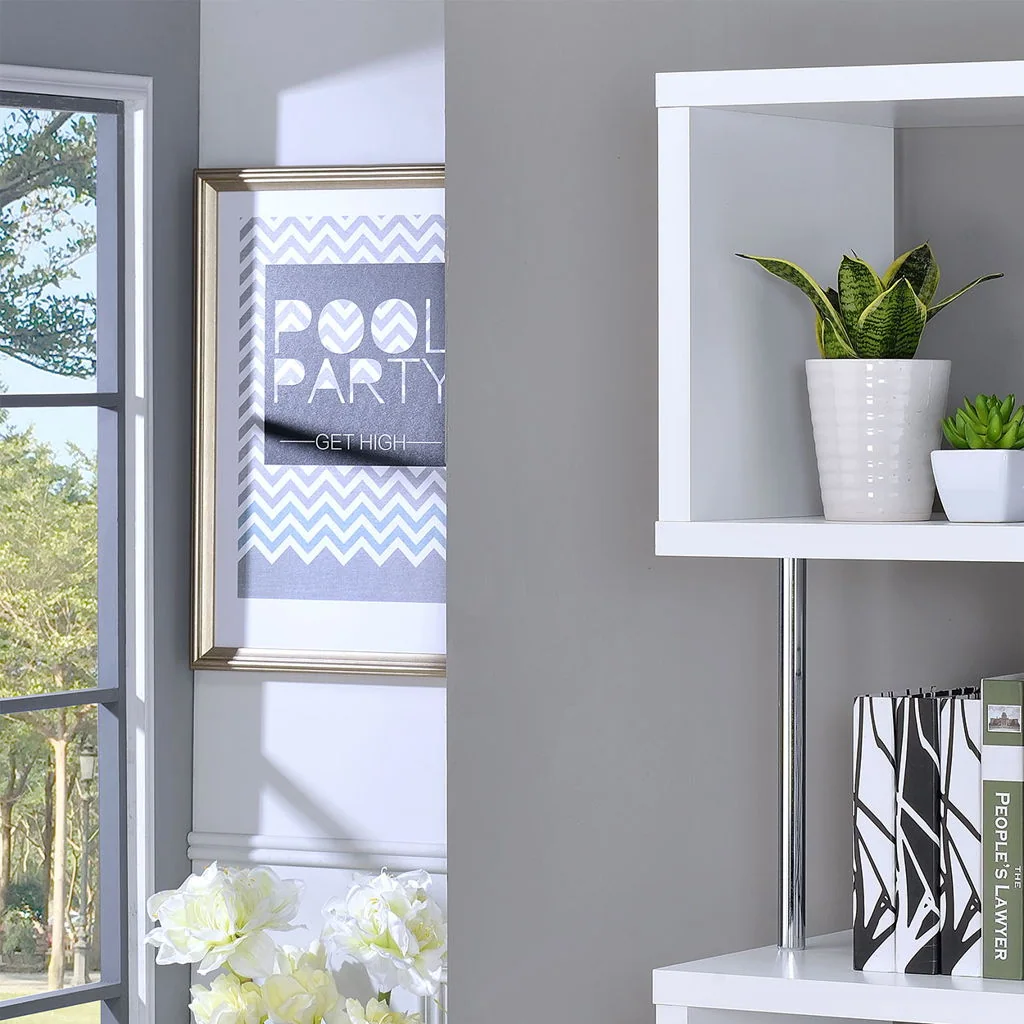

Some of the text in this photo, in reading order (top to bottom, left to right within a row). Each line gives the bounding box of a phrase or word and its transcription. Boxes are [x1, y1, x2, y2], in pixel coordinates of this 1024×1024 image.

[275, 299, 445, 354] POOL
[273, 358, 445, 404] PARTY
[315, 433, 406, 450] GET HIGH
[994, 792, 1011, 961] PEOPLE'S LAWYER
[1014, 865, 1022, 889] THE
